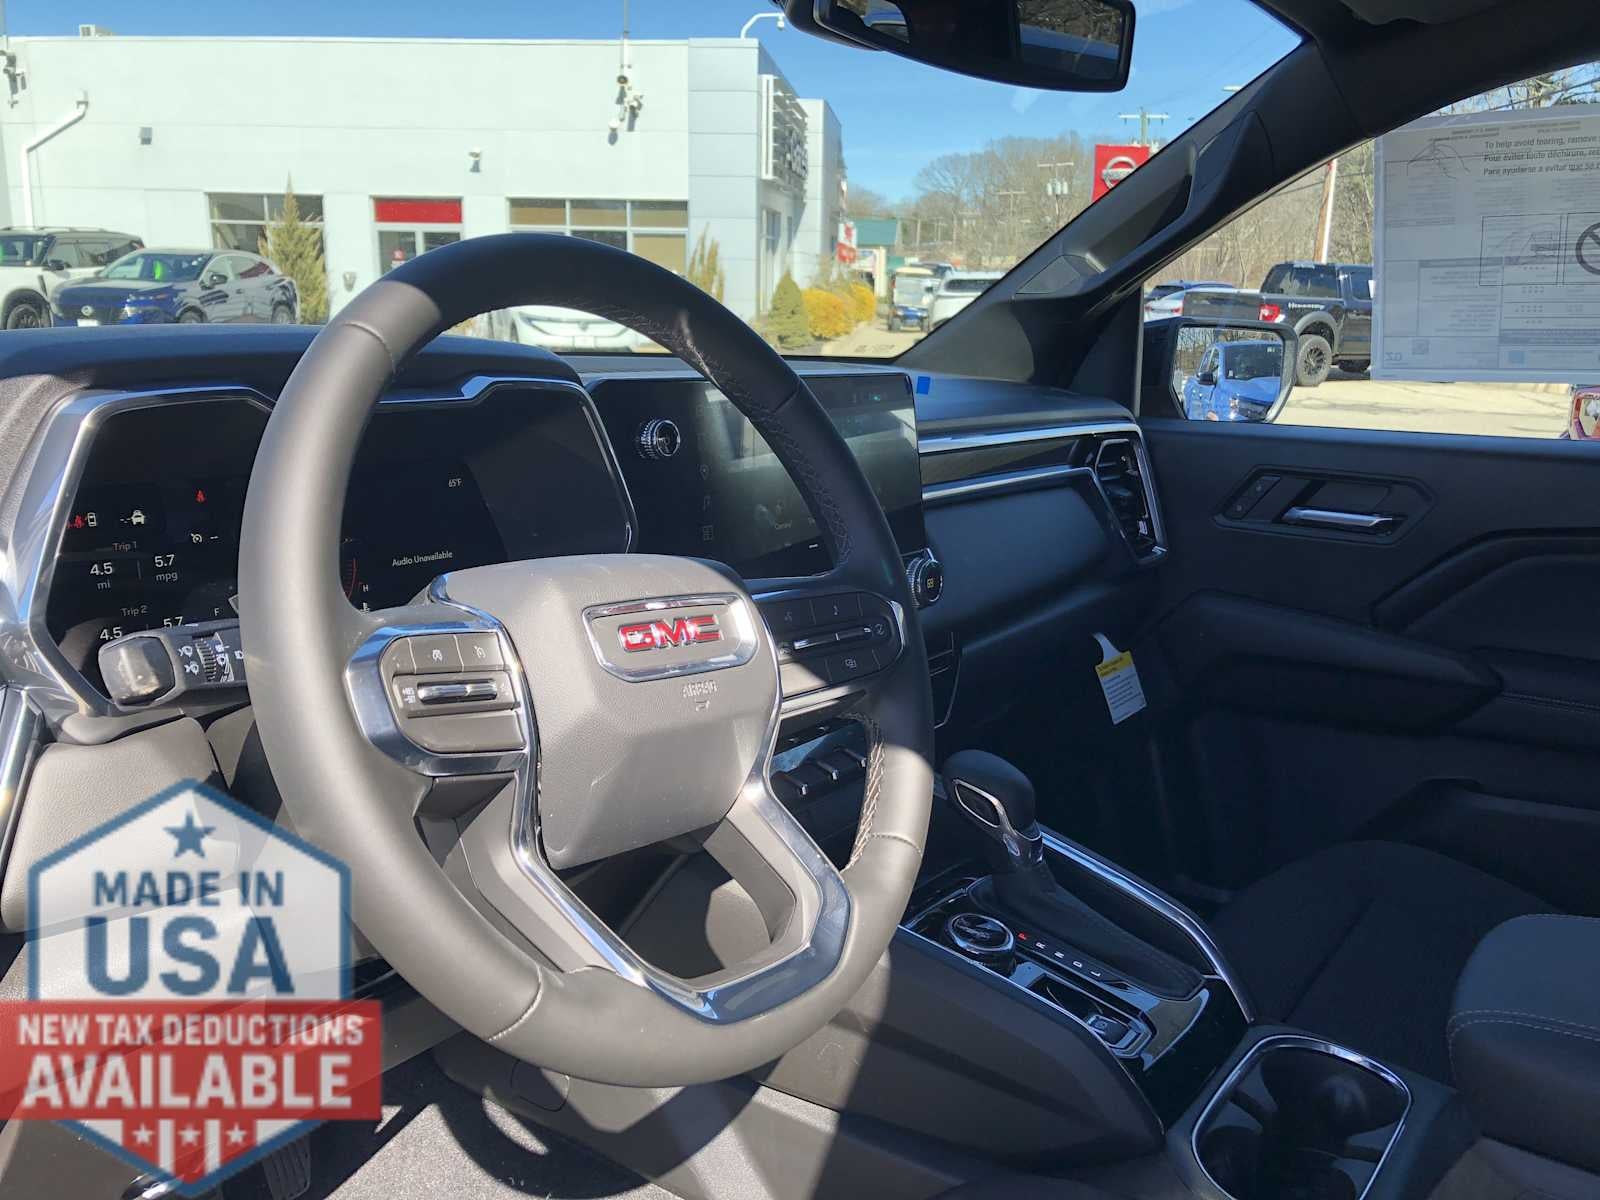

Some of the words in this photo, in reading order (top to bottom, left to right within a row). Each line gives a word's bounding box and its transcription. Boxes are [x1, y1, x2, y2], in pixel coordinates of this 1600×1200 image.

[113, 542, 131, 552] Trip
[133, 541, 137, 549] 1
[154, 554, 175, 568] 5.7
[392, 557, 413, 567] Audio
[414, 550, 453, 563] Unavailable
[90, 562, 113, 576] 4.5
[155, 571, 178, 582] mpg
[97, 580, 111, 590] mi
[362, 584, 369, 592] H
[120, 607, 139, 617] Trip
[140, 605, 148, 614] 2
[214, 607, 220, 616] F
[100, 627, 123, 641] 4.5
[618, 615, 724, 652] GMC
[1072, 960, 1082, 968] D
